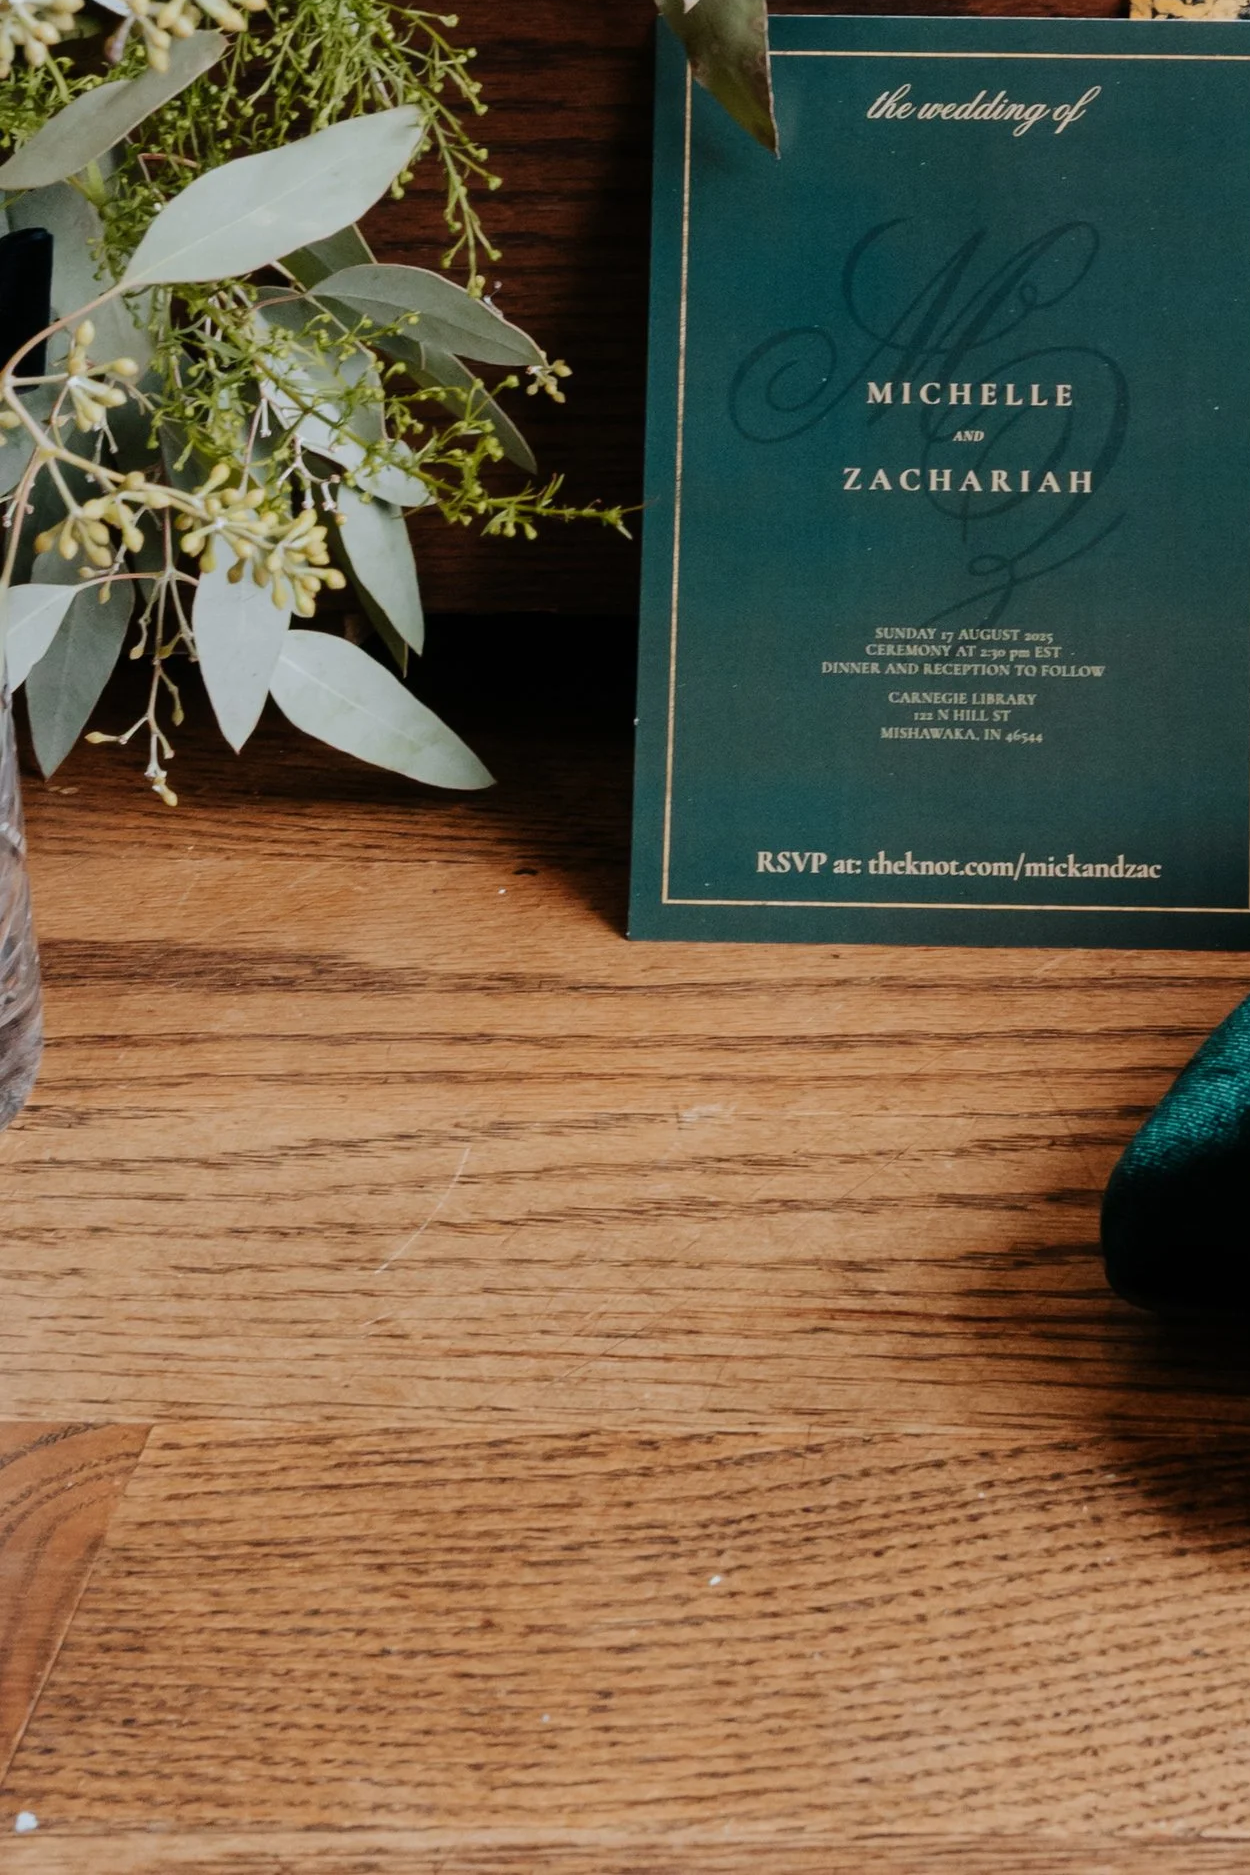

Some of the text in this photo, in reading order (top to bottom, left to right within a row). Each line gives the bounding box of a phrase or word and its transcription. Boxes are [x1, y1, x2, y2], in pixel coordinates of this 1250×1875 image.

[866, 83, 1101, 137] the wedding of
[867, 382, 1073, 407] MICHELLE
[953, 429, 985, 443] AND
[843, 467, 1093, 494] ZACHARIAH
[875, 627, 1054, 644] SUNDAY 17 AUGUST 2025
[865, 644, 1063, 662] CEREMONY AT 2:30 pm EST
[821, 661, 1106, 678] DINNER AND RECEPTION TO FOLLOW
[888, 691, 1038, 706] CARNEGIE LIBRARY
[913, 709, 1012, 722] 122 N HILL ST
[984, 728, 1001, 741] IN
[1005, 731, 1044, 745] 46544
[756, 851, 1162, 880] RSVP at: theknot.com/mickandzac
